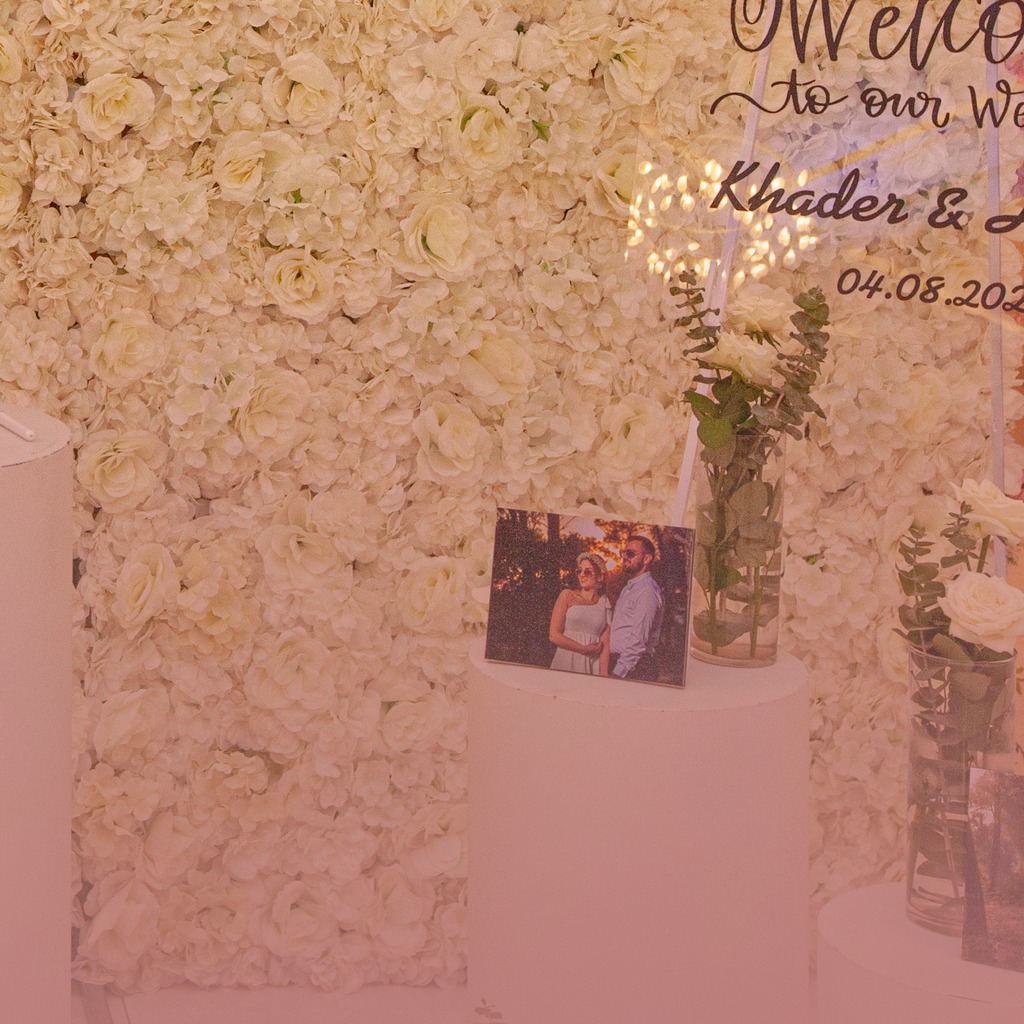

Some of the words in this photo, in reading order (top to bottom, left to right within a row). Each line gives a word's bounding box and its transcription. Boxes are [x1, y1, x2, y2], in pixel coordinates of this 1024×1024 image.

[710, 69, 849, 115] to
[860, 81, 951, 128] our
[709, 160, 909, 224] Khader
[927, 187, 965, 231] &
